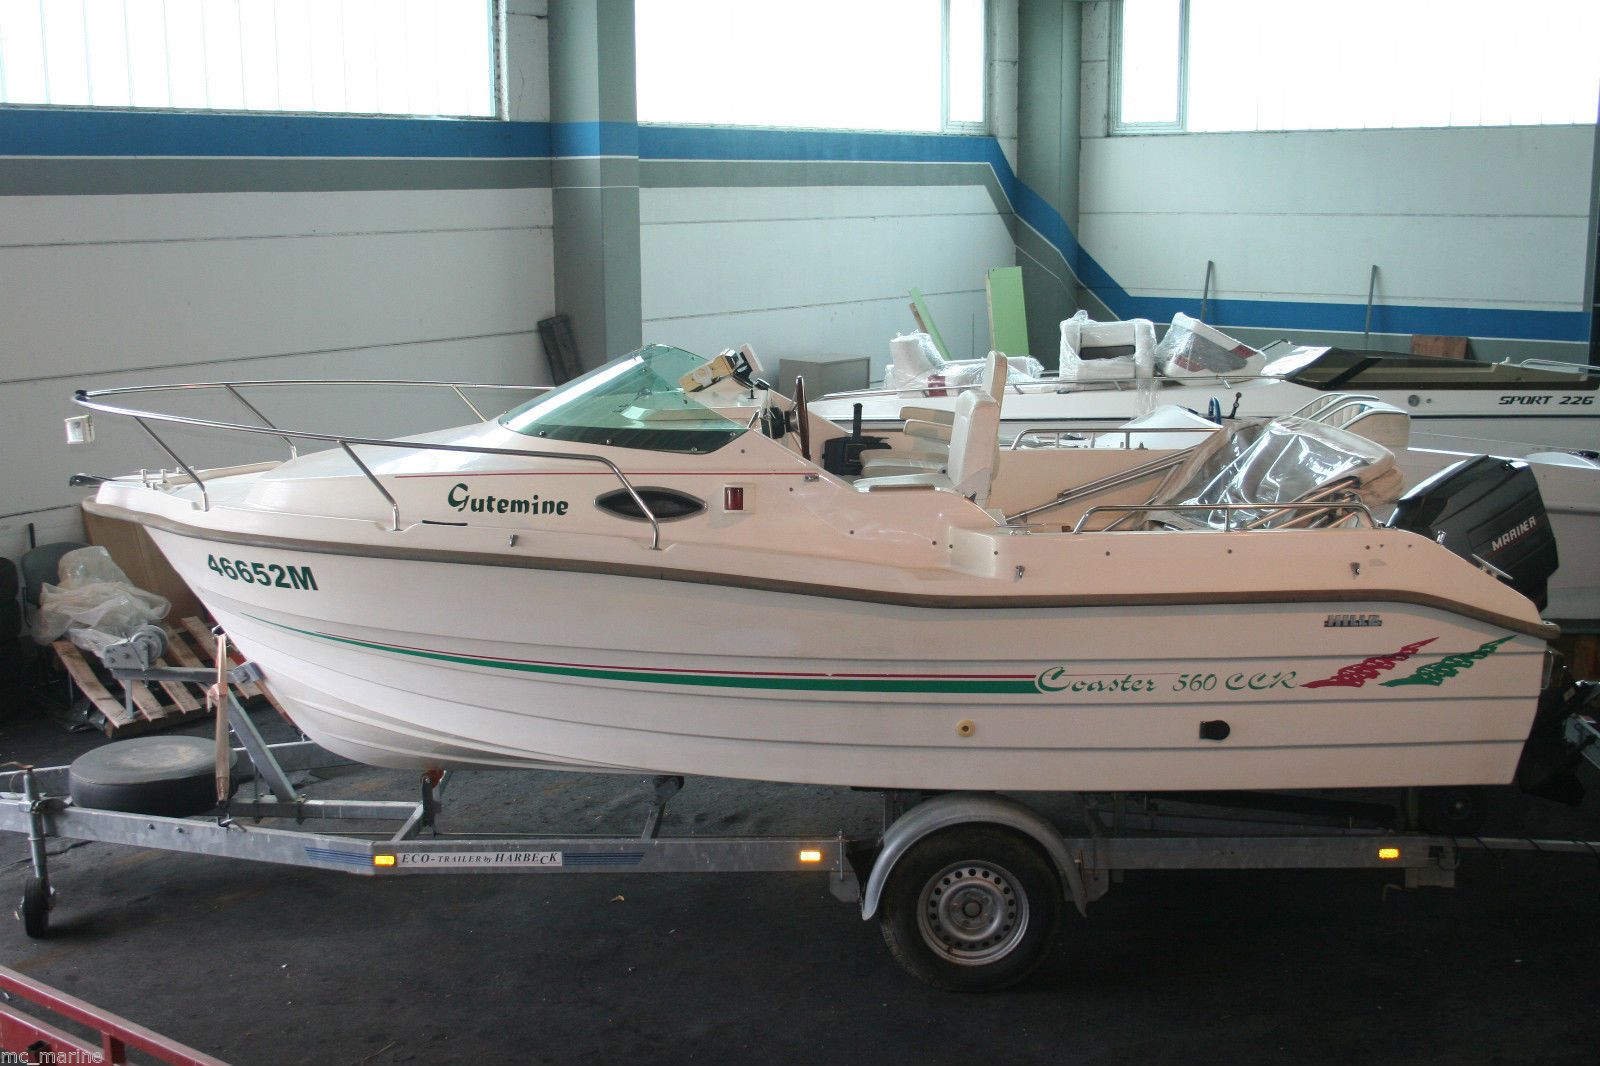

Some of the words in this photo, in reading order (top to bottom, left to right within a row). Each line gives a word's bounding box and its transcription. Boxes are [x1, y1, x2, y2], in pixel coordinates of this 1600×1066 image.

[1498, 395, 1553, 405] SPORT
[1559, 395, 1595, 405] 226
[447, 482, 569, 516] Gutemine
[1491, 515, 1536, 551] MARINER
[207, 553, 319, 591] 46652M
[1037, 666, 1156, 692] Coaster
[1172, 673, 1217, 692] 560
[1225, 670, 1299, 691] CCR
[483, 854, 492, 863] by
[494, 852, 558, 865] HARBECK
